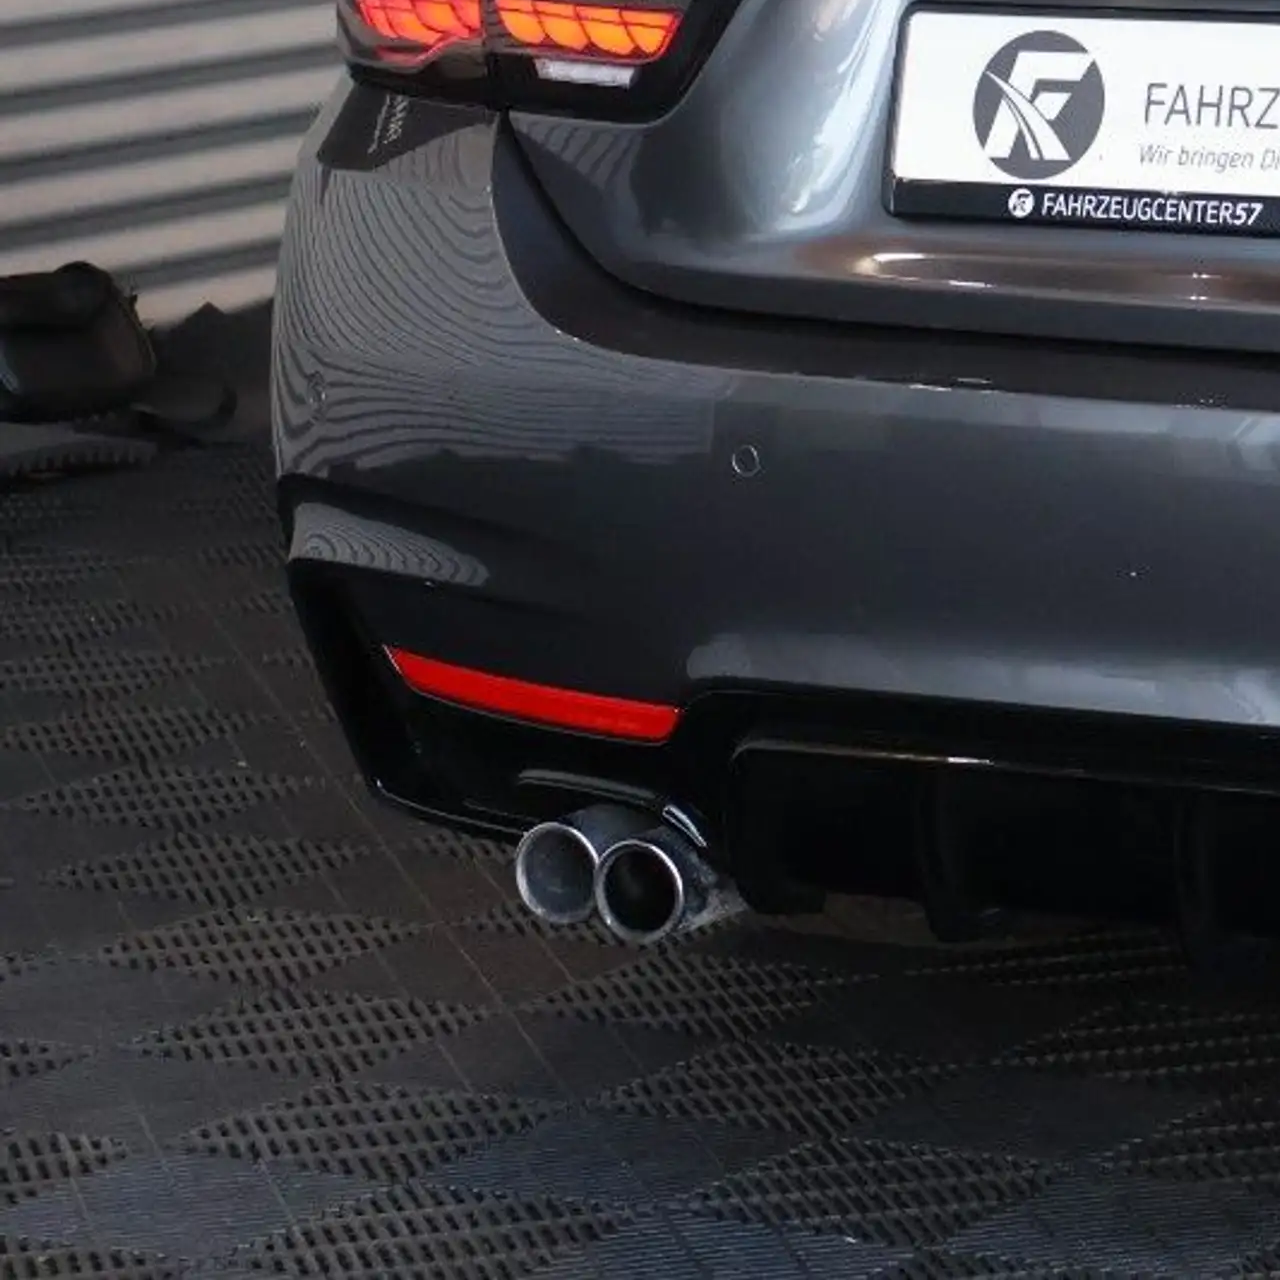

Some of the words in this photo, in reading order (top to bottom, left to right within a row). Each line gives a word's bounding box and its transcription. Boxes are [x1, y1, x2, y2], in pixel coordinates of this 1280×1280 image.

[1139, 143, 1173, 166] Wir
[1177, 145, 1254, 174] bringen
[1041, 192, 1264, 226] FAHRZEUGCENTER57
